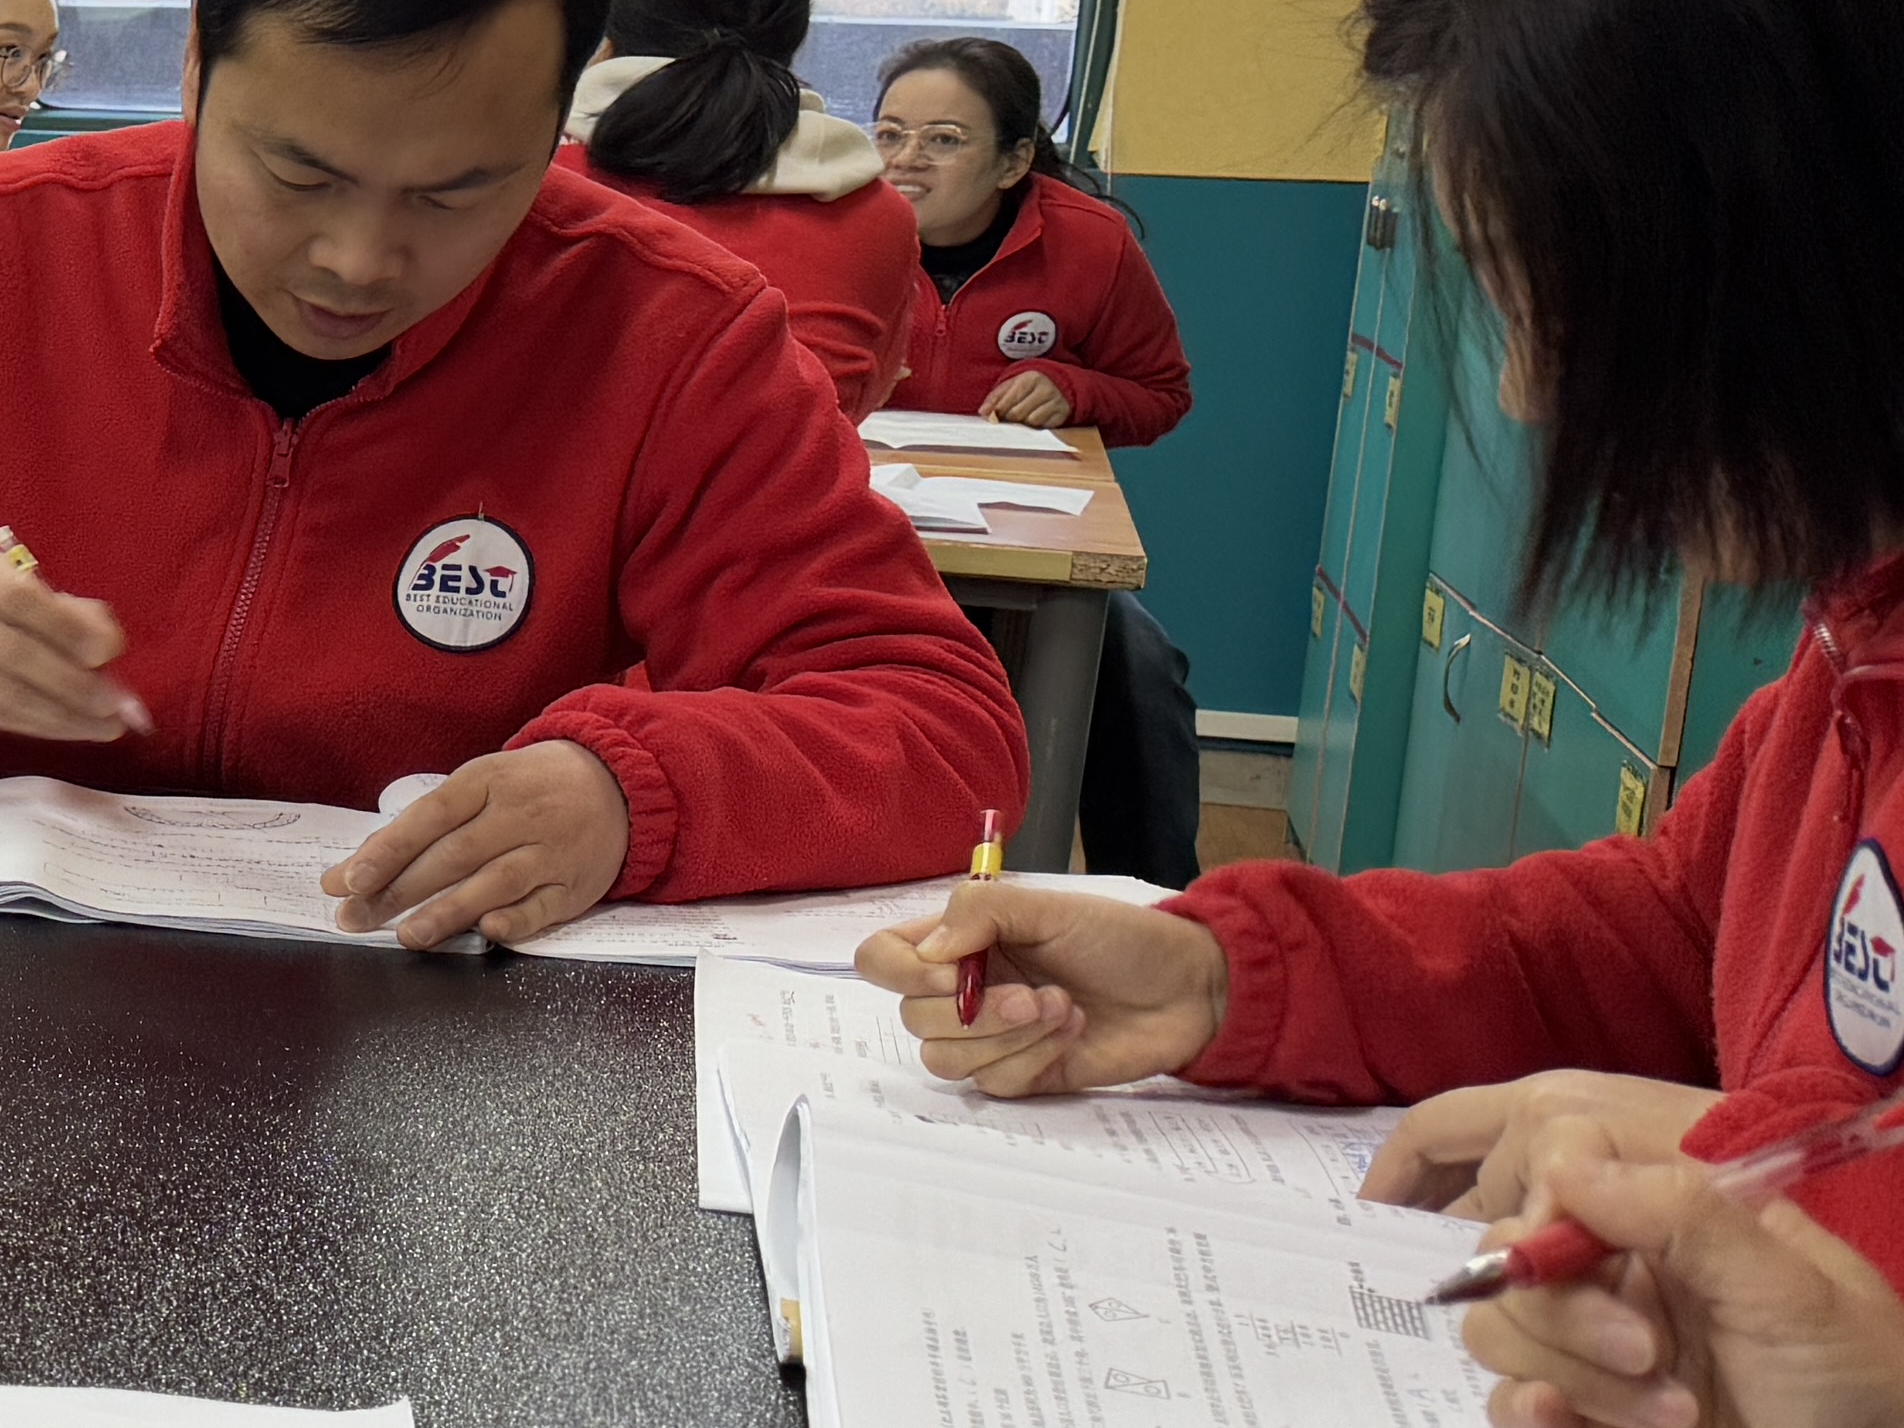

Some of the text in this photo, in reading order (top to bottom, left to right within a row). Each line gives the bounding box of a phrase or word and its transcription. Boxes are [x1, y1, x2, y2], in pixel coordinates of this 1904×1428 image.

[411, 564, 517, 598] BEST
[405, 592, 514, 612] BEST EDUCATIONAL
[416, 604, 503, 621] ORGANIZATION
